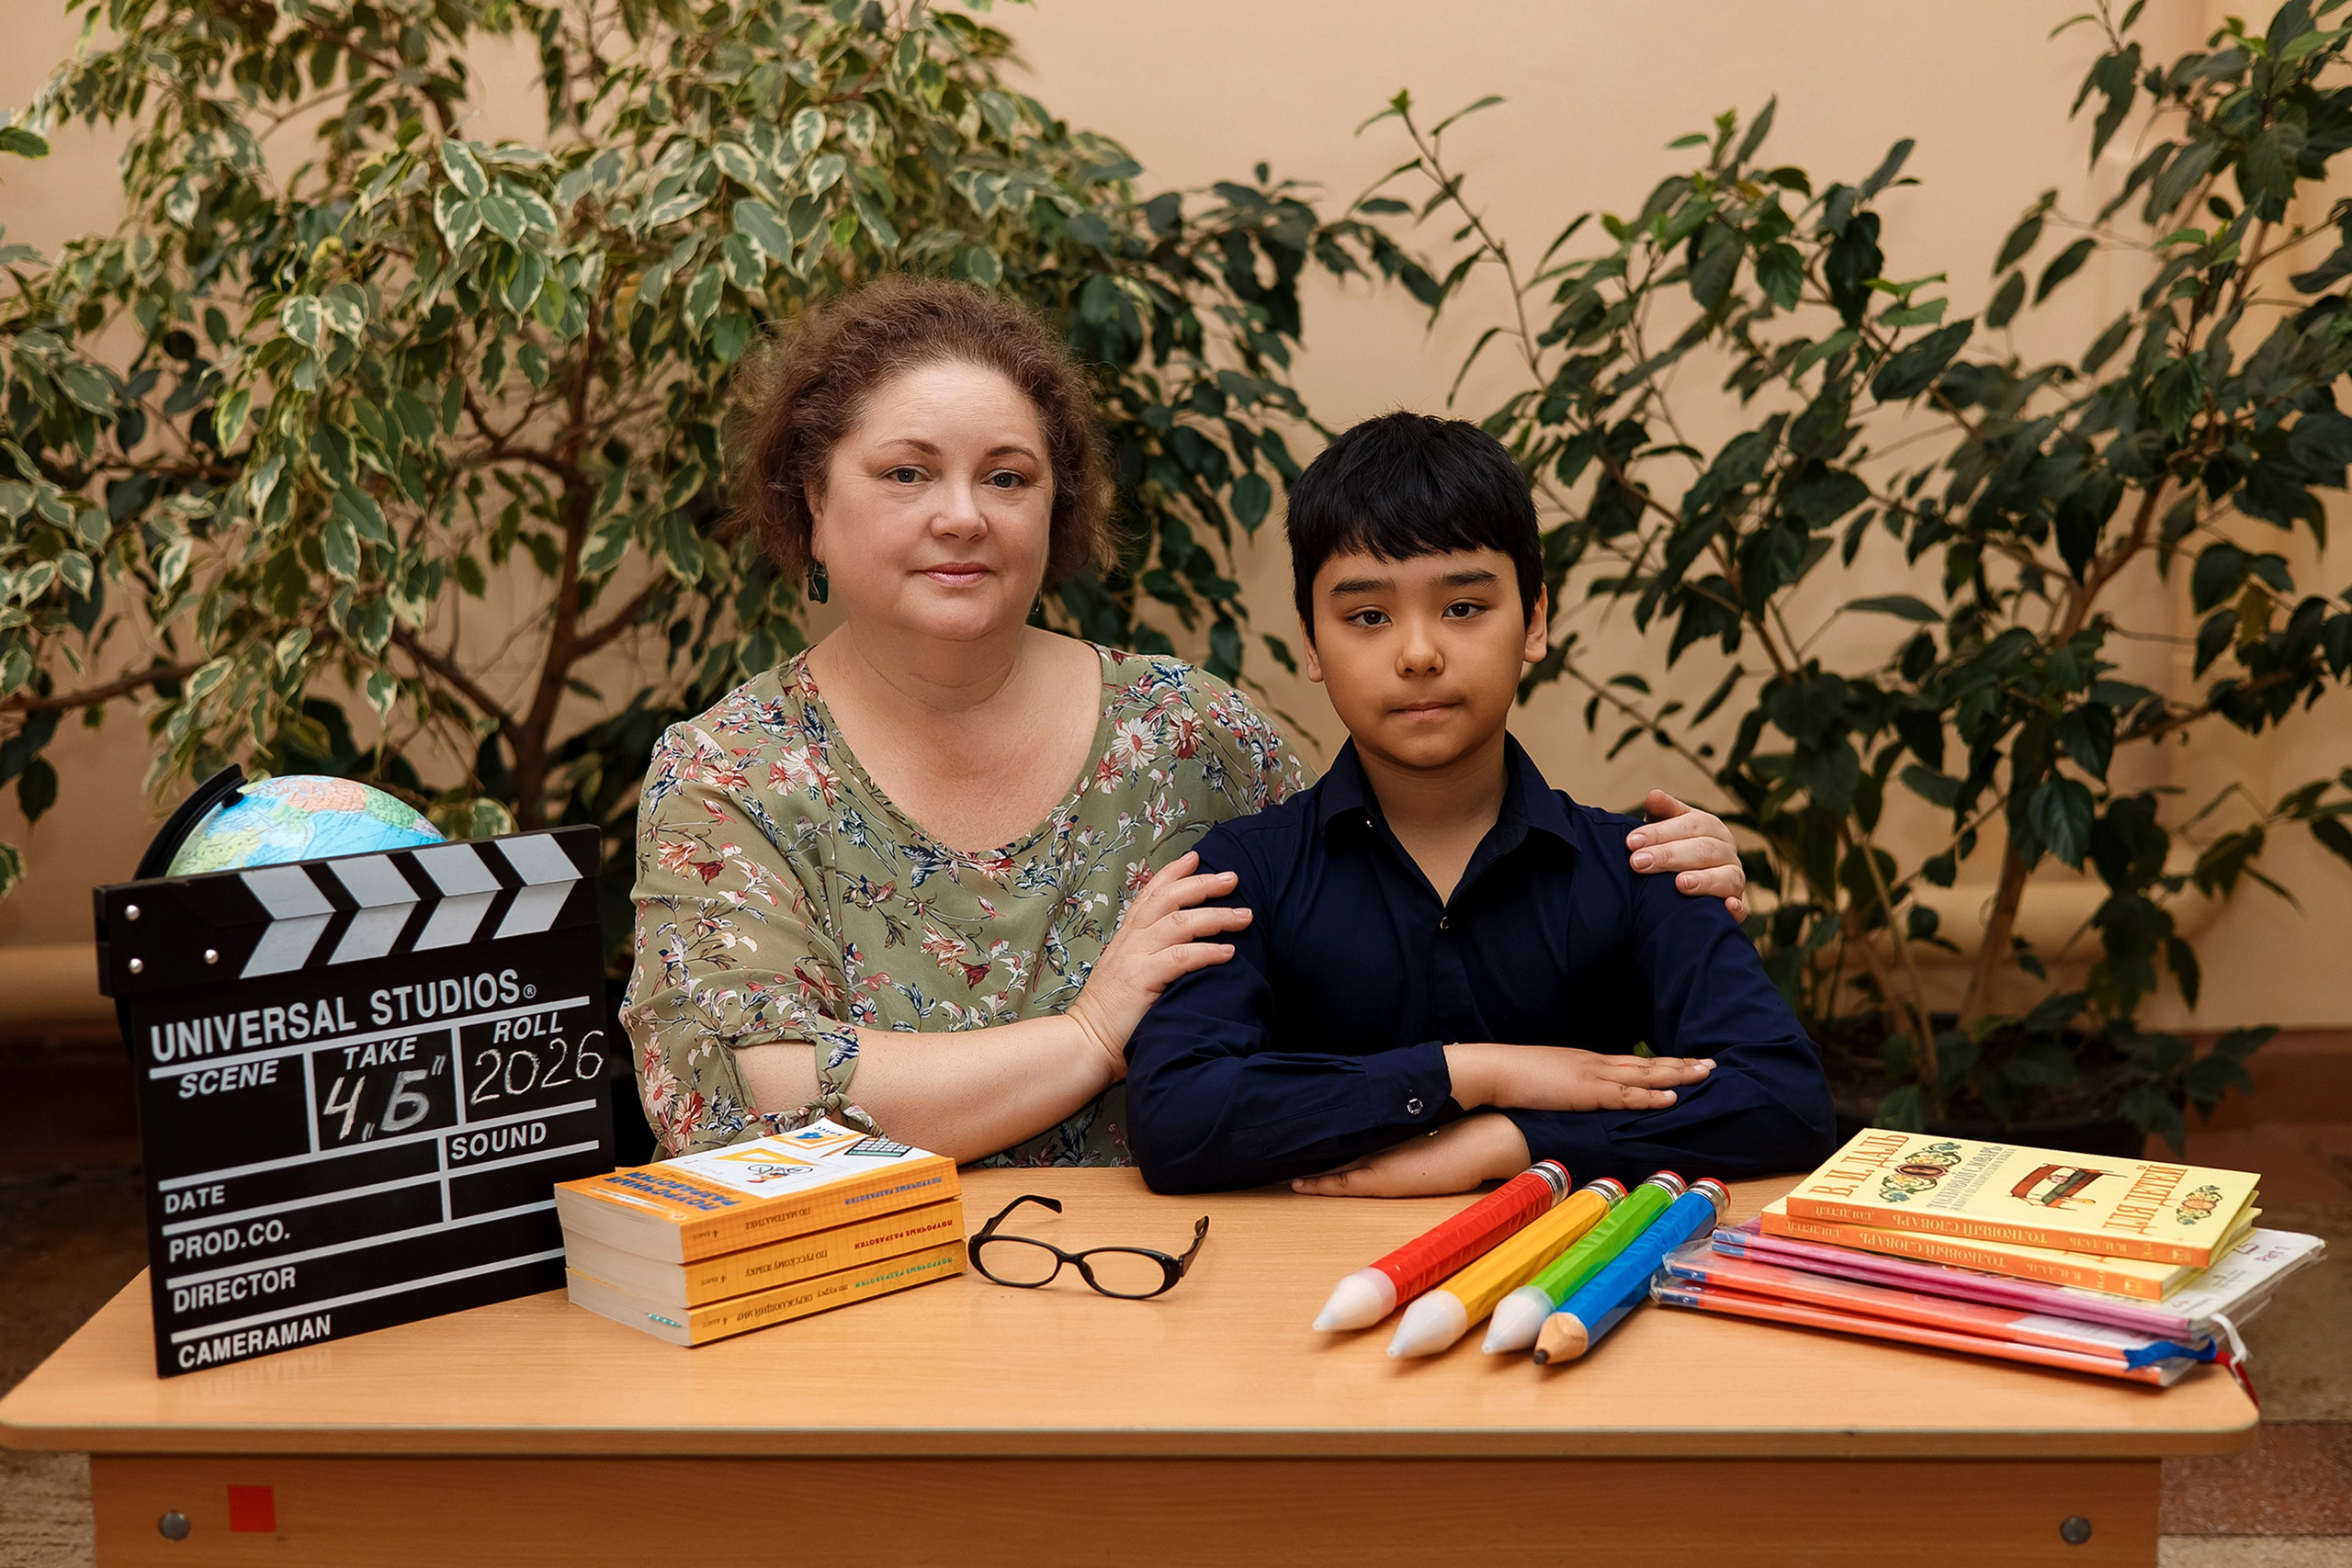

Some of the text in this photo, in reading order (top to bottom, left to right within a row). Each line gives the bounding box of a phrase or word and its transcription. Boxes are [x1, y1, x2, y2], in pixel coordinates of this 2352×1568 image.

[150, 996, 357, 1062] UNIVERSAL
[493, 1011, 563, 1043] ROLL
[344, 1037, 417, 1070] TAKE
[178, 1060, 279, 1098] SCENE
[470, 1030, 605, 1106] 2026
[451, 1122, 547, 1160] SOUND
[1808, 1134, 1910, 1198] В. И. ДАЛЬ
[604, 1177, 720, 1212] ПОУРОЧНЫЕ
[625, 1171, 741, 1207] РАЗРАБОТКИ
[895, 1177, 942, 1193] ПОУРОЧНЫЕ
[164, 1185, 225, 1213] DATE
[845, 1188, 894, 1205] РАЗРАБОТКИ
[2102, 1165, 2188, 1235] ДЛЯ ДЕТЕЙ
[745, 1210, 797, 1231] МАТЕМАТИКЕ
[799, 1207, 811, 1215] ПО
[1815, 1205, 1851, 1218] ДЕТЕЙ
[906, 1220, 953, 1236] ПОУРОЧНЫЕ
[1787, 1222, 1821, 1235] ДЕТЕЙ
[1893, 1213, 1959, 1233] СЛОВАРЬ
[1962, 1222, 2048, 1244] ТОЛКОВЫЙ
[169, 1219, 290, 1263] PROD.CO.
[854, 1232, 903, 1249] РАЗРАБОТКИ
[1859, 1233, 1922, 1253] СЛОВАРЬ
[773, 1253, 815, 1270] РУССКОМУ
[816, 1249, 828, 1259] ПО
[1926, 1244, 2006, 1268] ТОЛКОВЫЙ
[745, 1264, 772, 1278] ЯЗЫКУ
[906, 1258, 953, 1274] ПОУРОЧНЫЕ
[855, 1269, 904, 1288] РАЗРАБОТКИ
[173, 1267, 296, 1314] DIRECTOR
[737, 1311, 753, 1322] МИР
[754, 1294, 813, 1317] ОКРУЖАЮЩИЙ
[178, 1314, 331, 1369] CAMERAMAN
